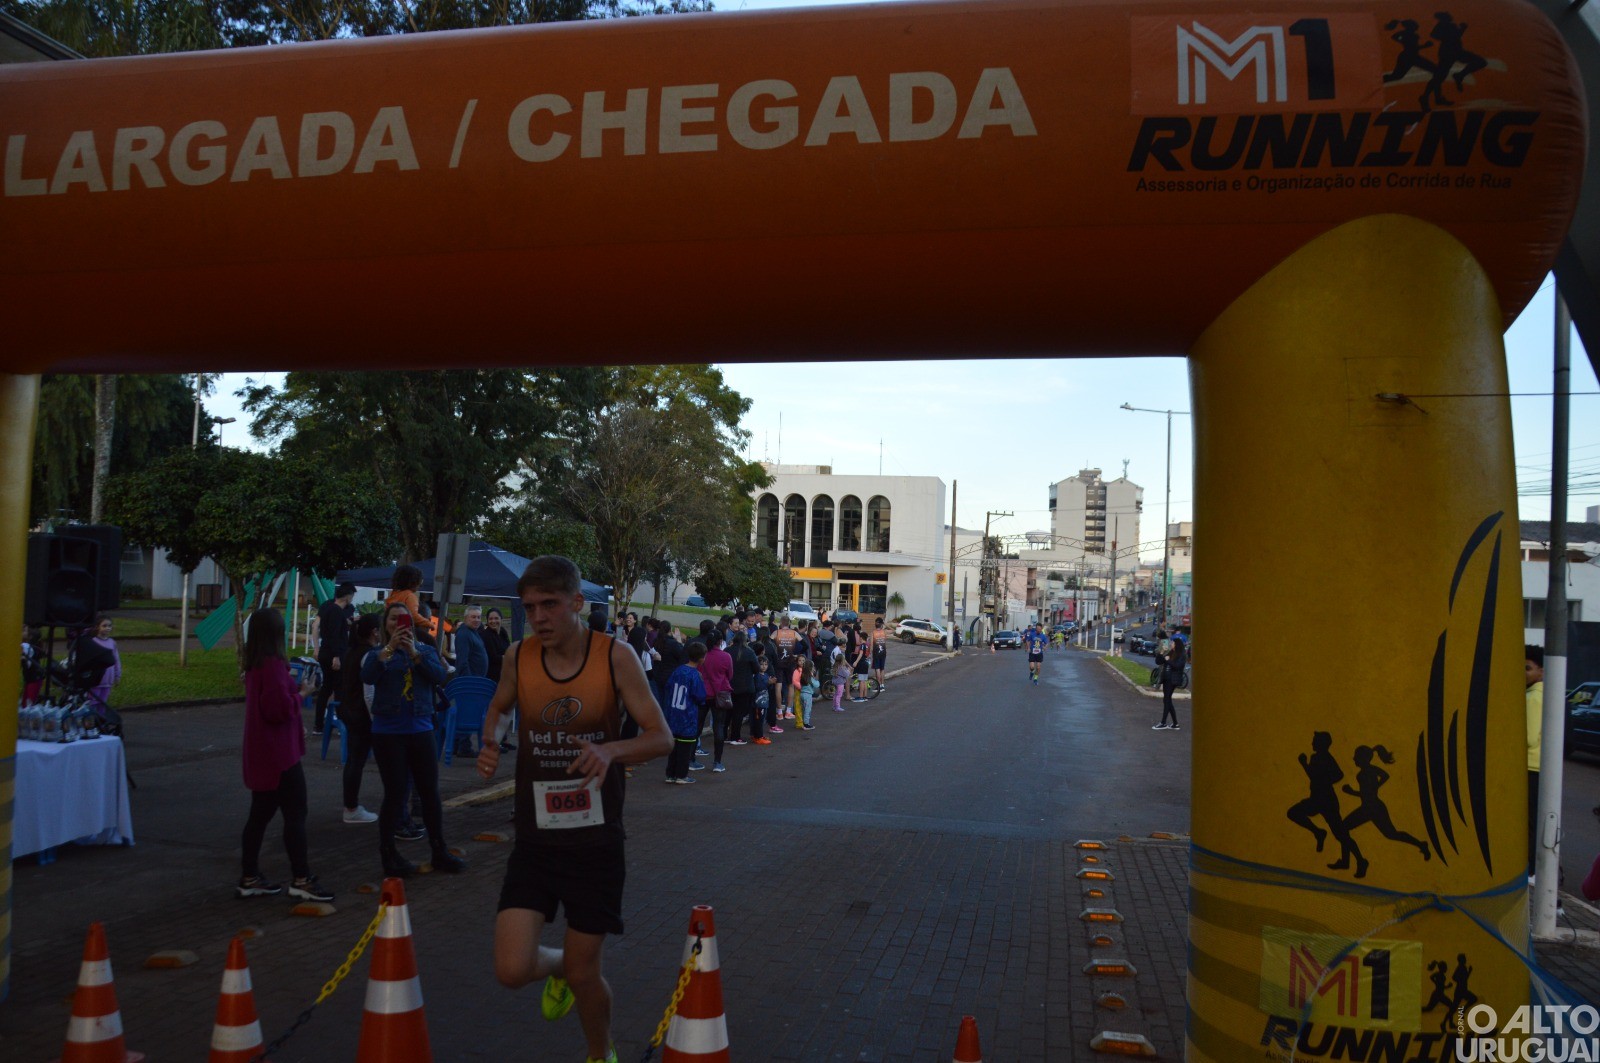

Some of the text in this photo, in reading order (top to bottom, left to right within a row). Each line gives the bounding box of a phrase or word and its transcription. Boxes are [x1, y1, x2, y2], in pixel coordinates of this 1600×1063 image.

[1177, 18, 1335, 105] M1
[4, 67, 1038, 197] LARGADA / CHEGADA
[1126, 110, 1541, 172] RUNNING
[1136, 172, 1513, 194] Assessoria e Organização de Corrida de Rua
[671, 682, 688, 711] 10
[533, 746, 583, 757] Academ
[551, 793, 587, 810] 068
[1288, 943, 1391, 1020] M1
[1260, 1014, 1498, 1063] RUNNIN
